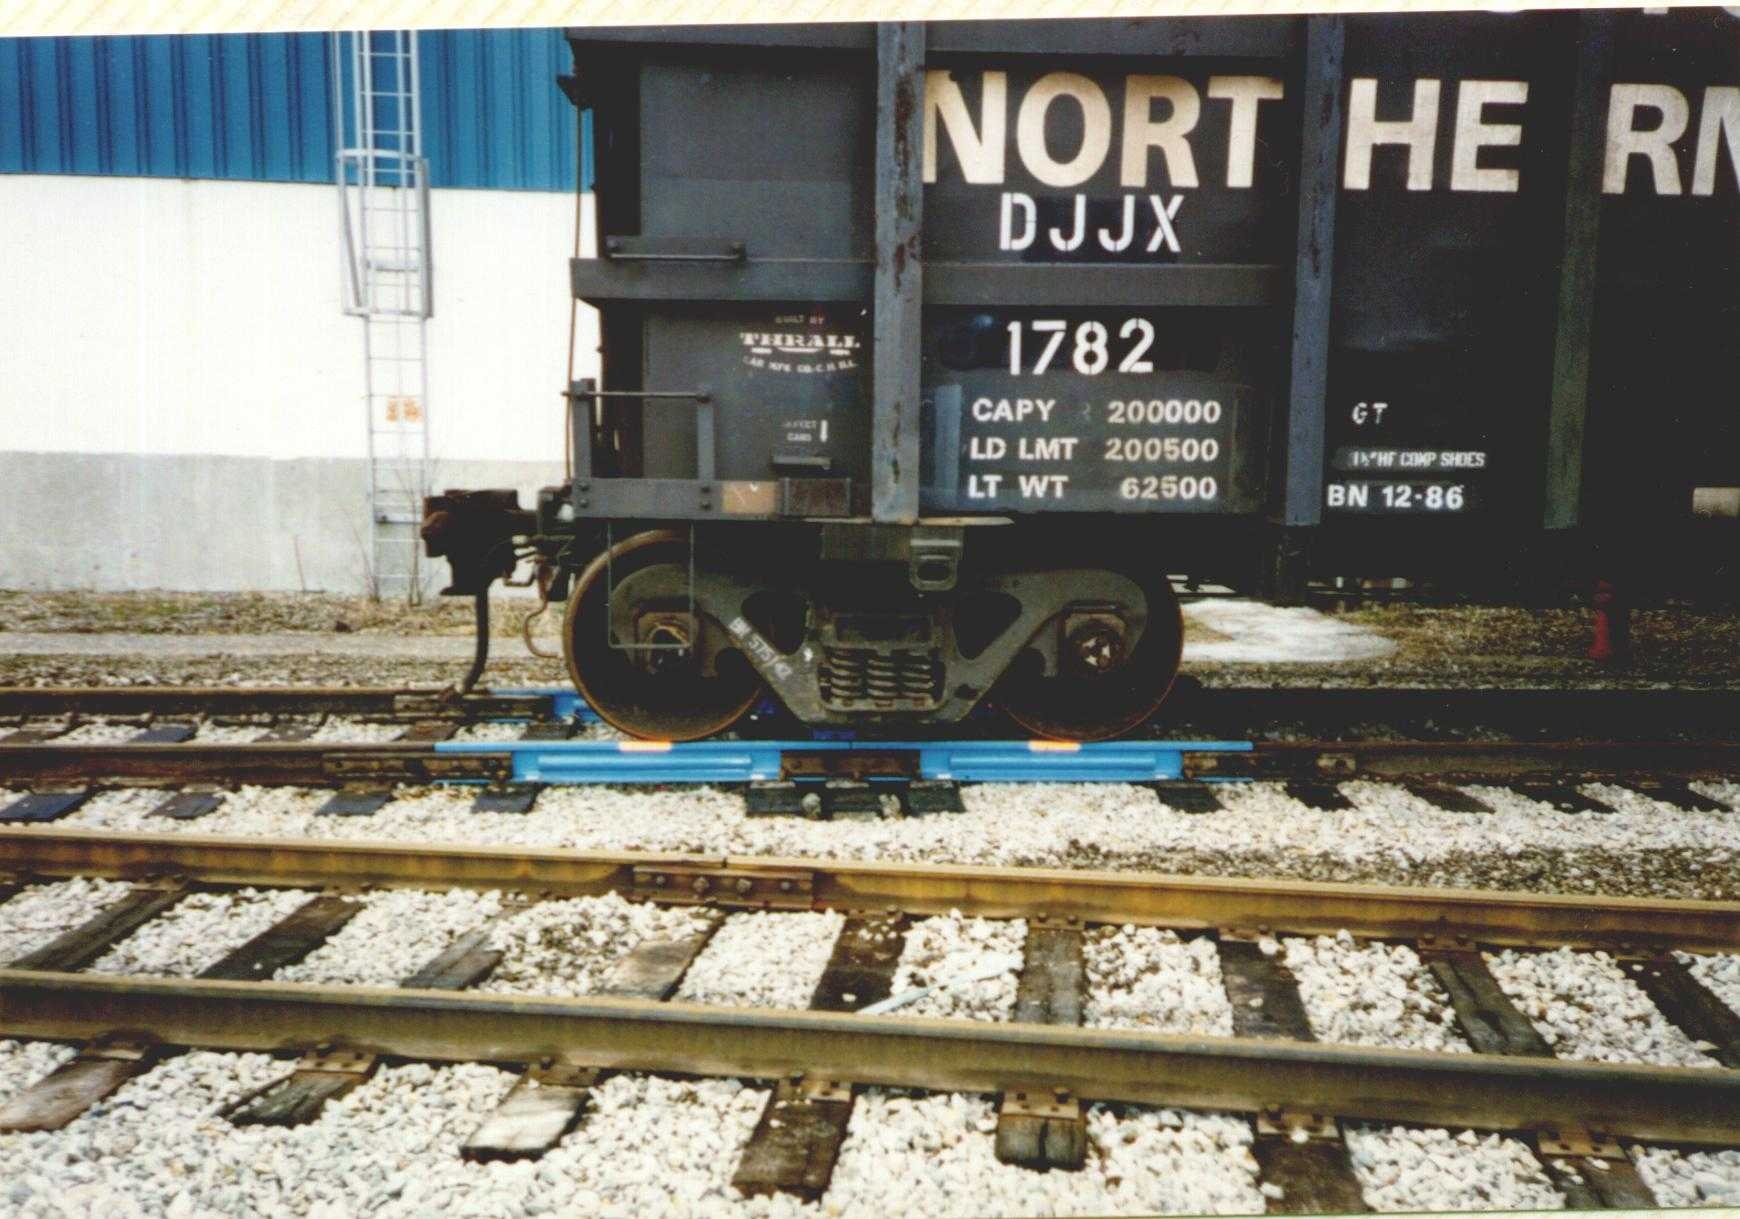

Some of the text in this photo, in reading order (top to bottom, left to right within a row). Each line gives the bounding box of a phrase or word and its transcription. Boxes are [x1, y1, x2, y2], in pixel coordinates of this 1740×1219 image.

[999, 192, 1185, 252] DJJX
[739, 332, 860, 348] THRALL
[1007, 318, 1155, 376] 1782
[972, 398, 1222, 424] CAPY 200000
[970, 437, 1219, 462] LD LMT 200500
[1400, 452, 1437, 467] COMP
[1440, 452, 1486, 467] SHOES
[968, 475, 1218, 500] LT WT 62500
[1327, 484, 1465, 510] BN 12-86
